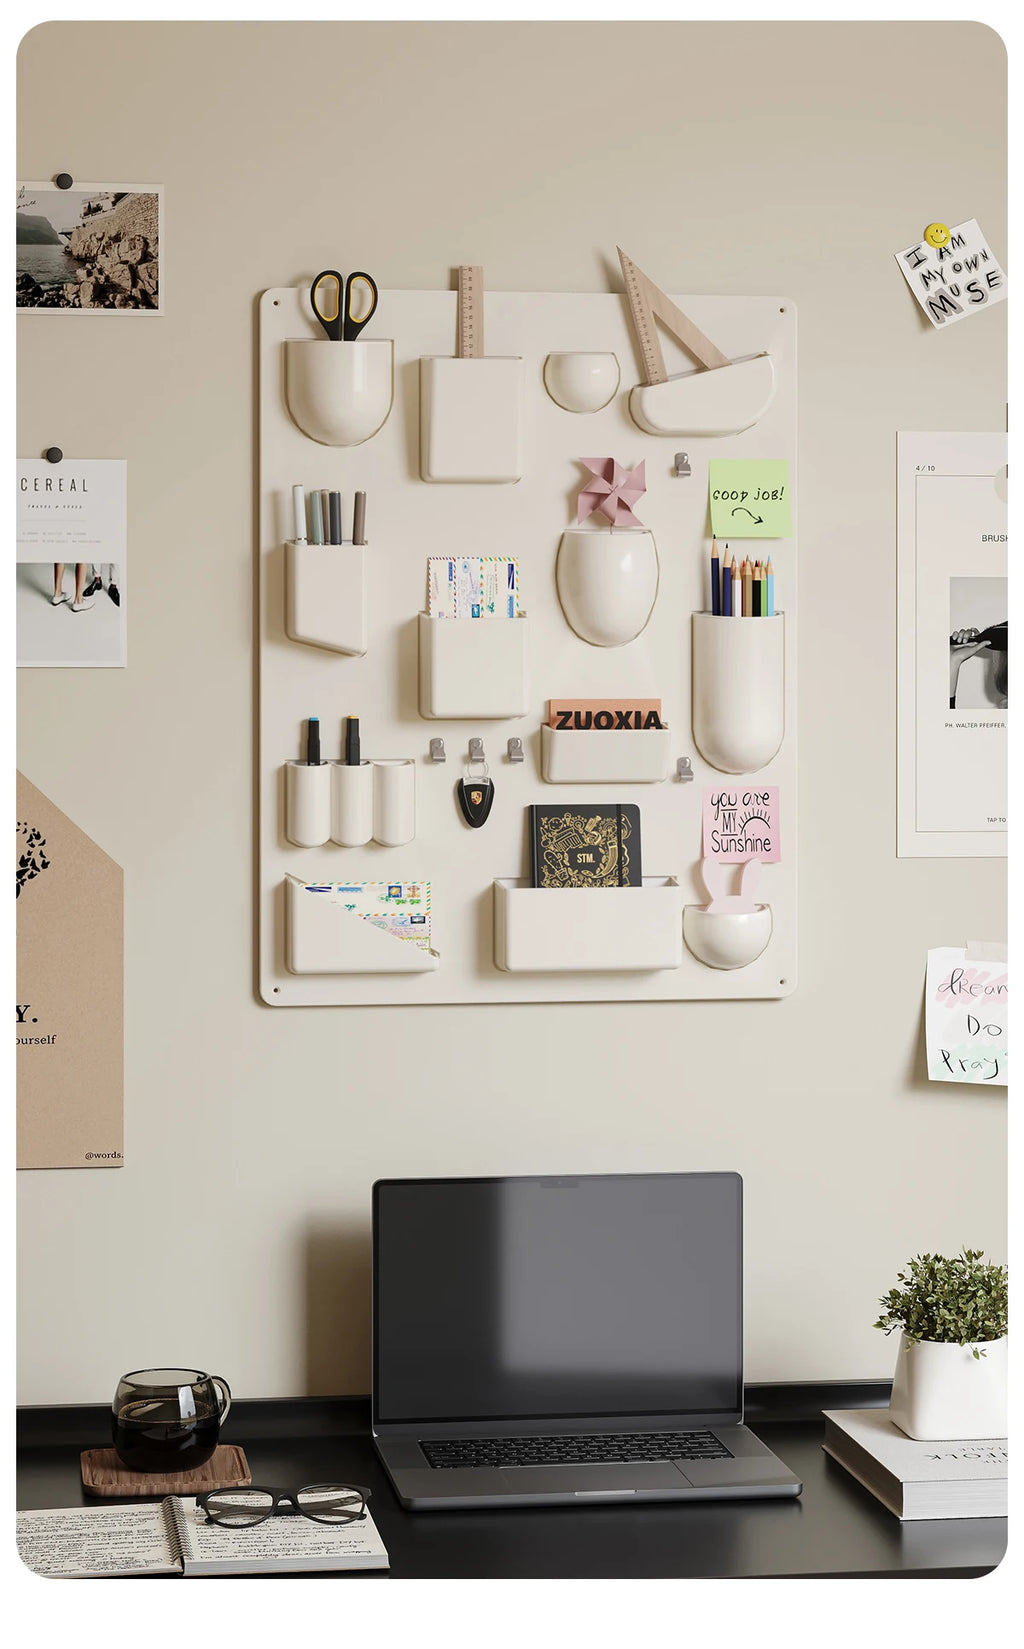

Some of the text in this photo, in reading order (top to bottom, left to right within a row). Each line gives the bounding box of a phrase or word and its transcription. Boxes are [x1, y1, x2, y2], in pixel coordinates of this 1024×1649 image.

[905, 246, 927, 269] I
[921, 249, 989, 288] MY OWN
[928, 270, 1001, 320] MUSE
[20, 477, 88, 492] CEREAL
[556, 711, 663, 730] ZUOXIA
[710, 792, 770, 821] you are
[722, 811, 737, 833] MY
[711, 829, 772, 853] Sunshine
[576, 853, 596, 863] STM.
[966, 1014, 1003, 1036] Do
